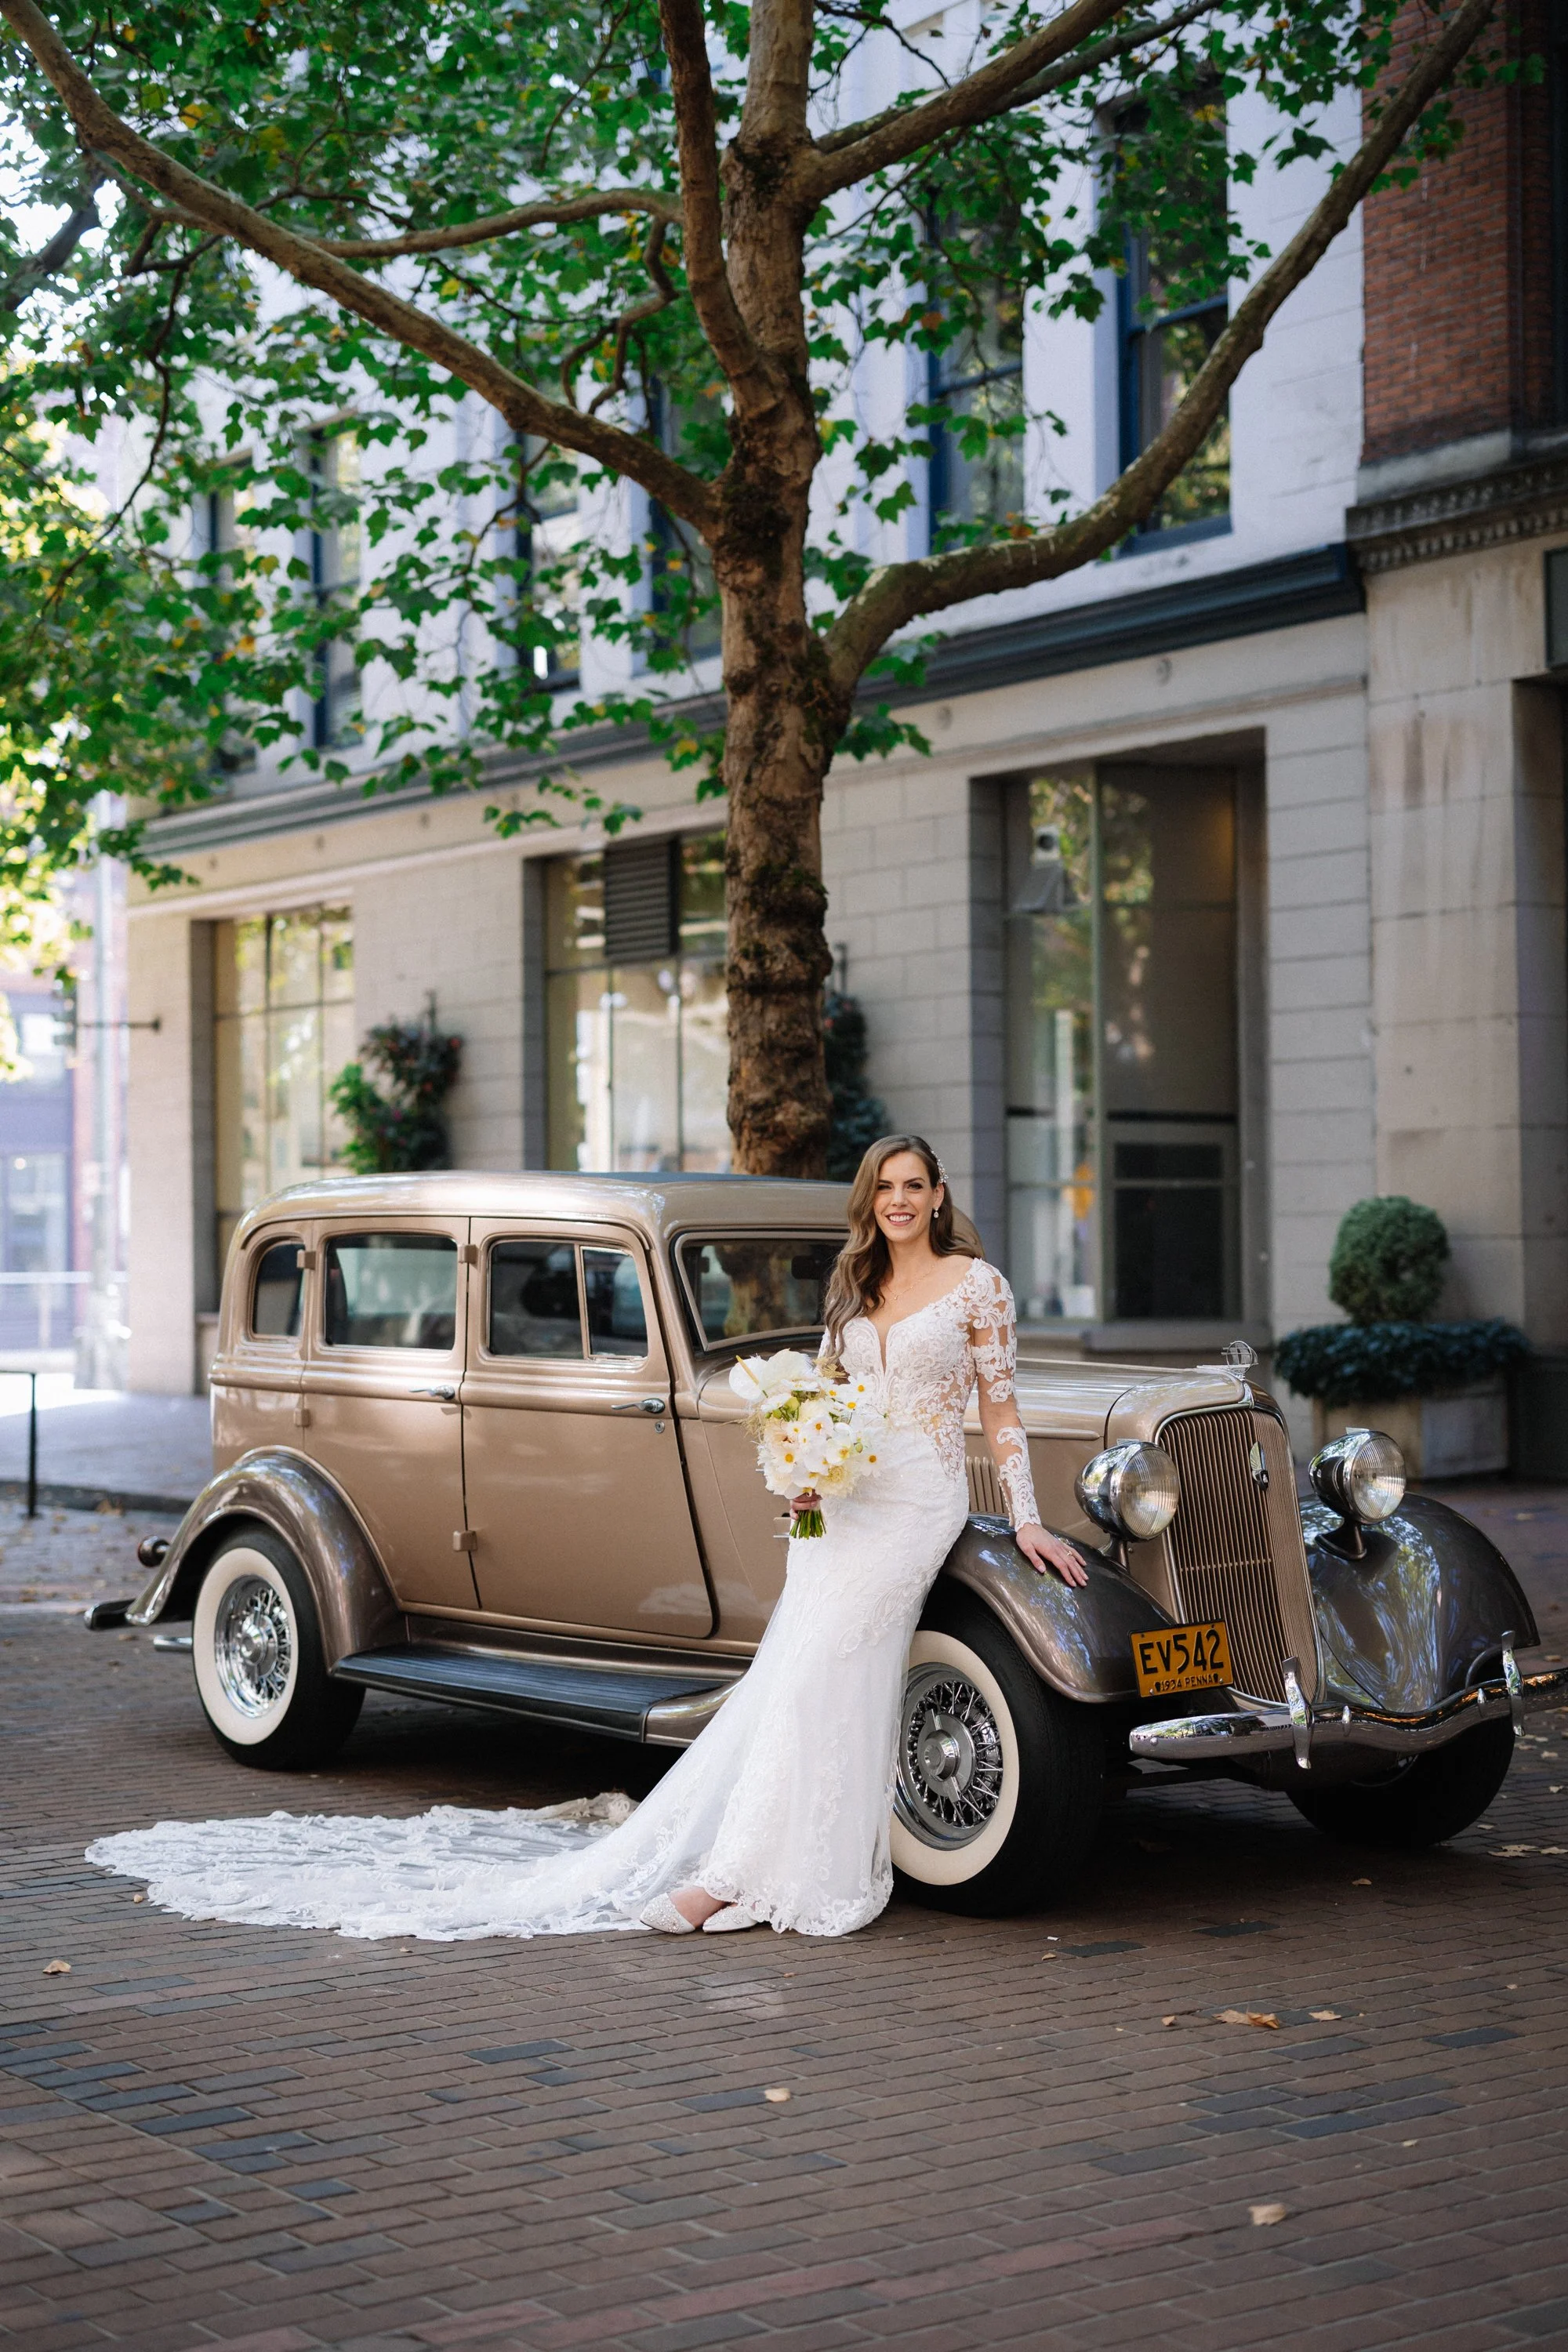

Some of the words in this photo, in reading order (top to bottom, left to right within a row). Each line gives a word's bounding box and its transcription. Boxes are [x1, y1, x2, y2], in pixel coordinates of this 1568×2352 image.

[1138, 1629, 1224, 1675] EV542
[1161, 1677, 1182, 1691] 1934
[1185, 1674, 1214, 1688] PENNA
